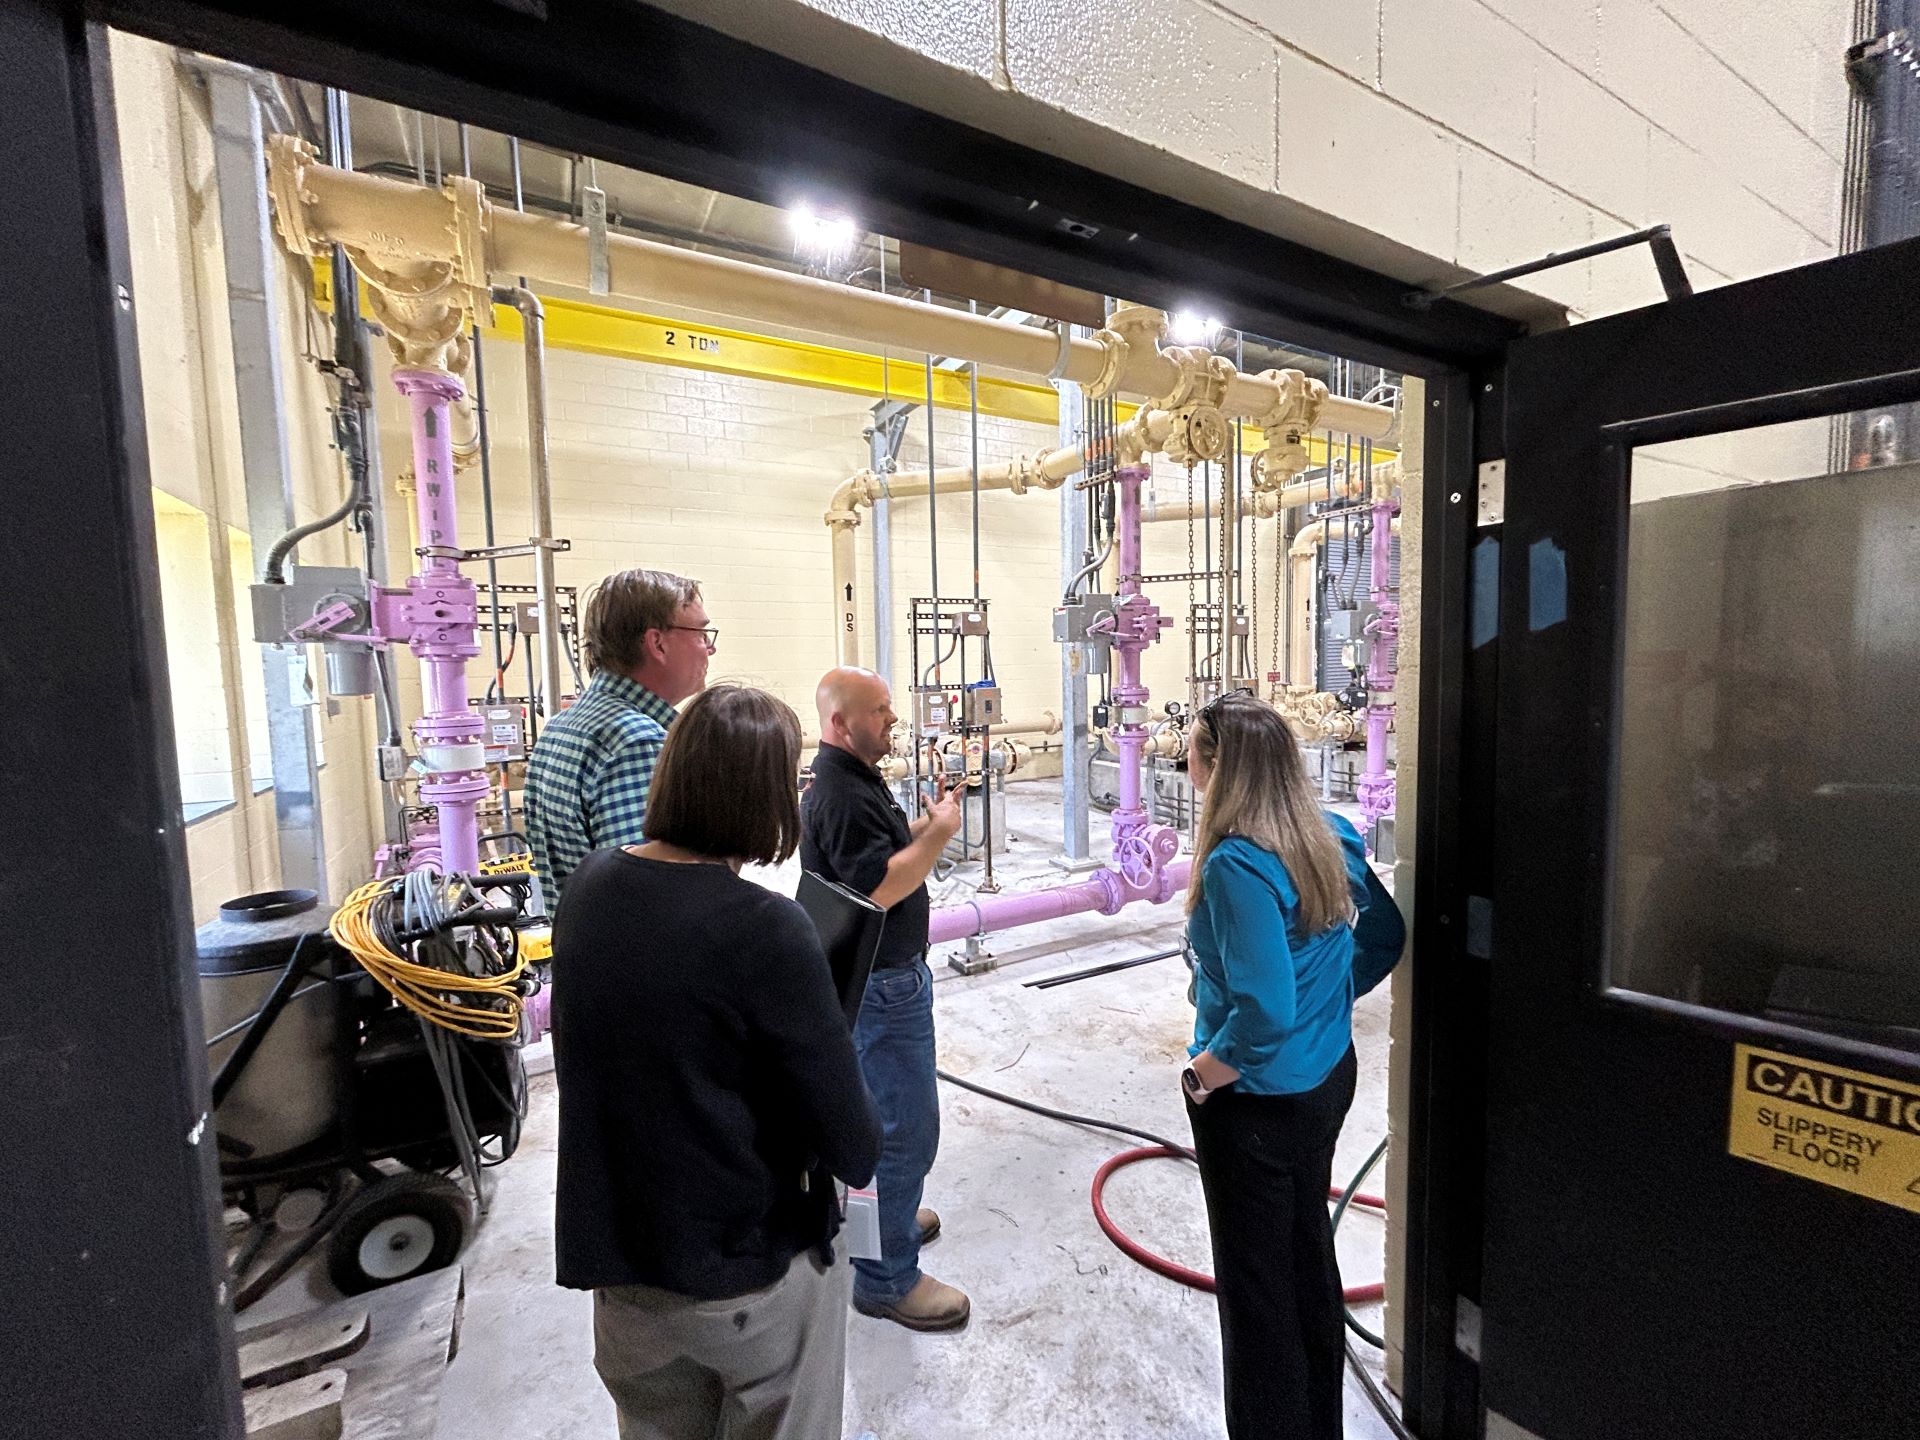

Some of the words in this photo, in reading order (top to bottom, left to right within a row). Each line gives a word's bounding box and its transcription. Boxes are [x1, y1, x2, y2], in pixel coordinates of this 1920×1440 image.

[665, 331, 675, 346] 2
[688, 335, 719, 352] TON
[846, 612, 854, 632] DS
[1757, 1107, 1882, 1156] SLIPPERY
[1773, 1133, 1860, 1175] FLOOR
